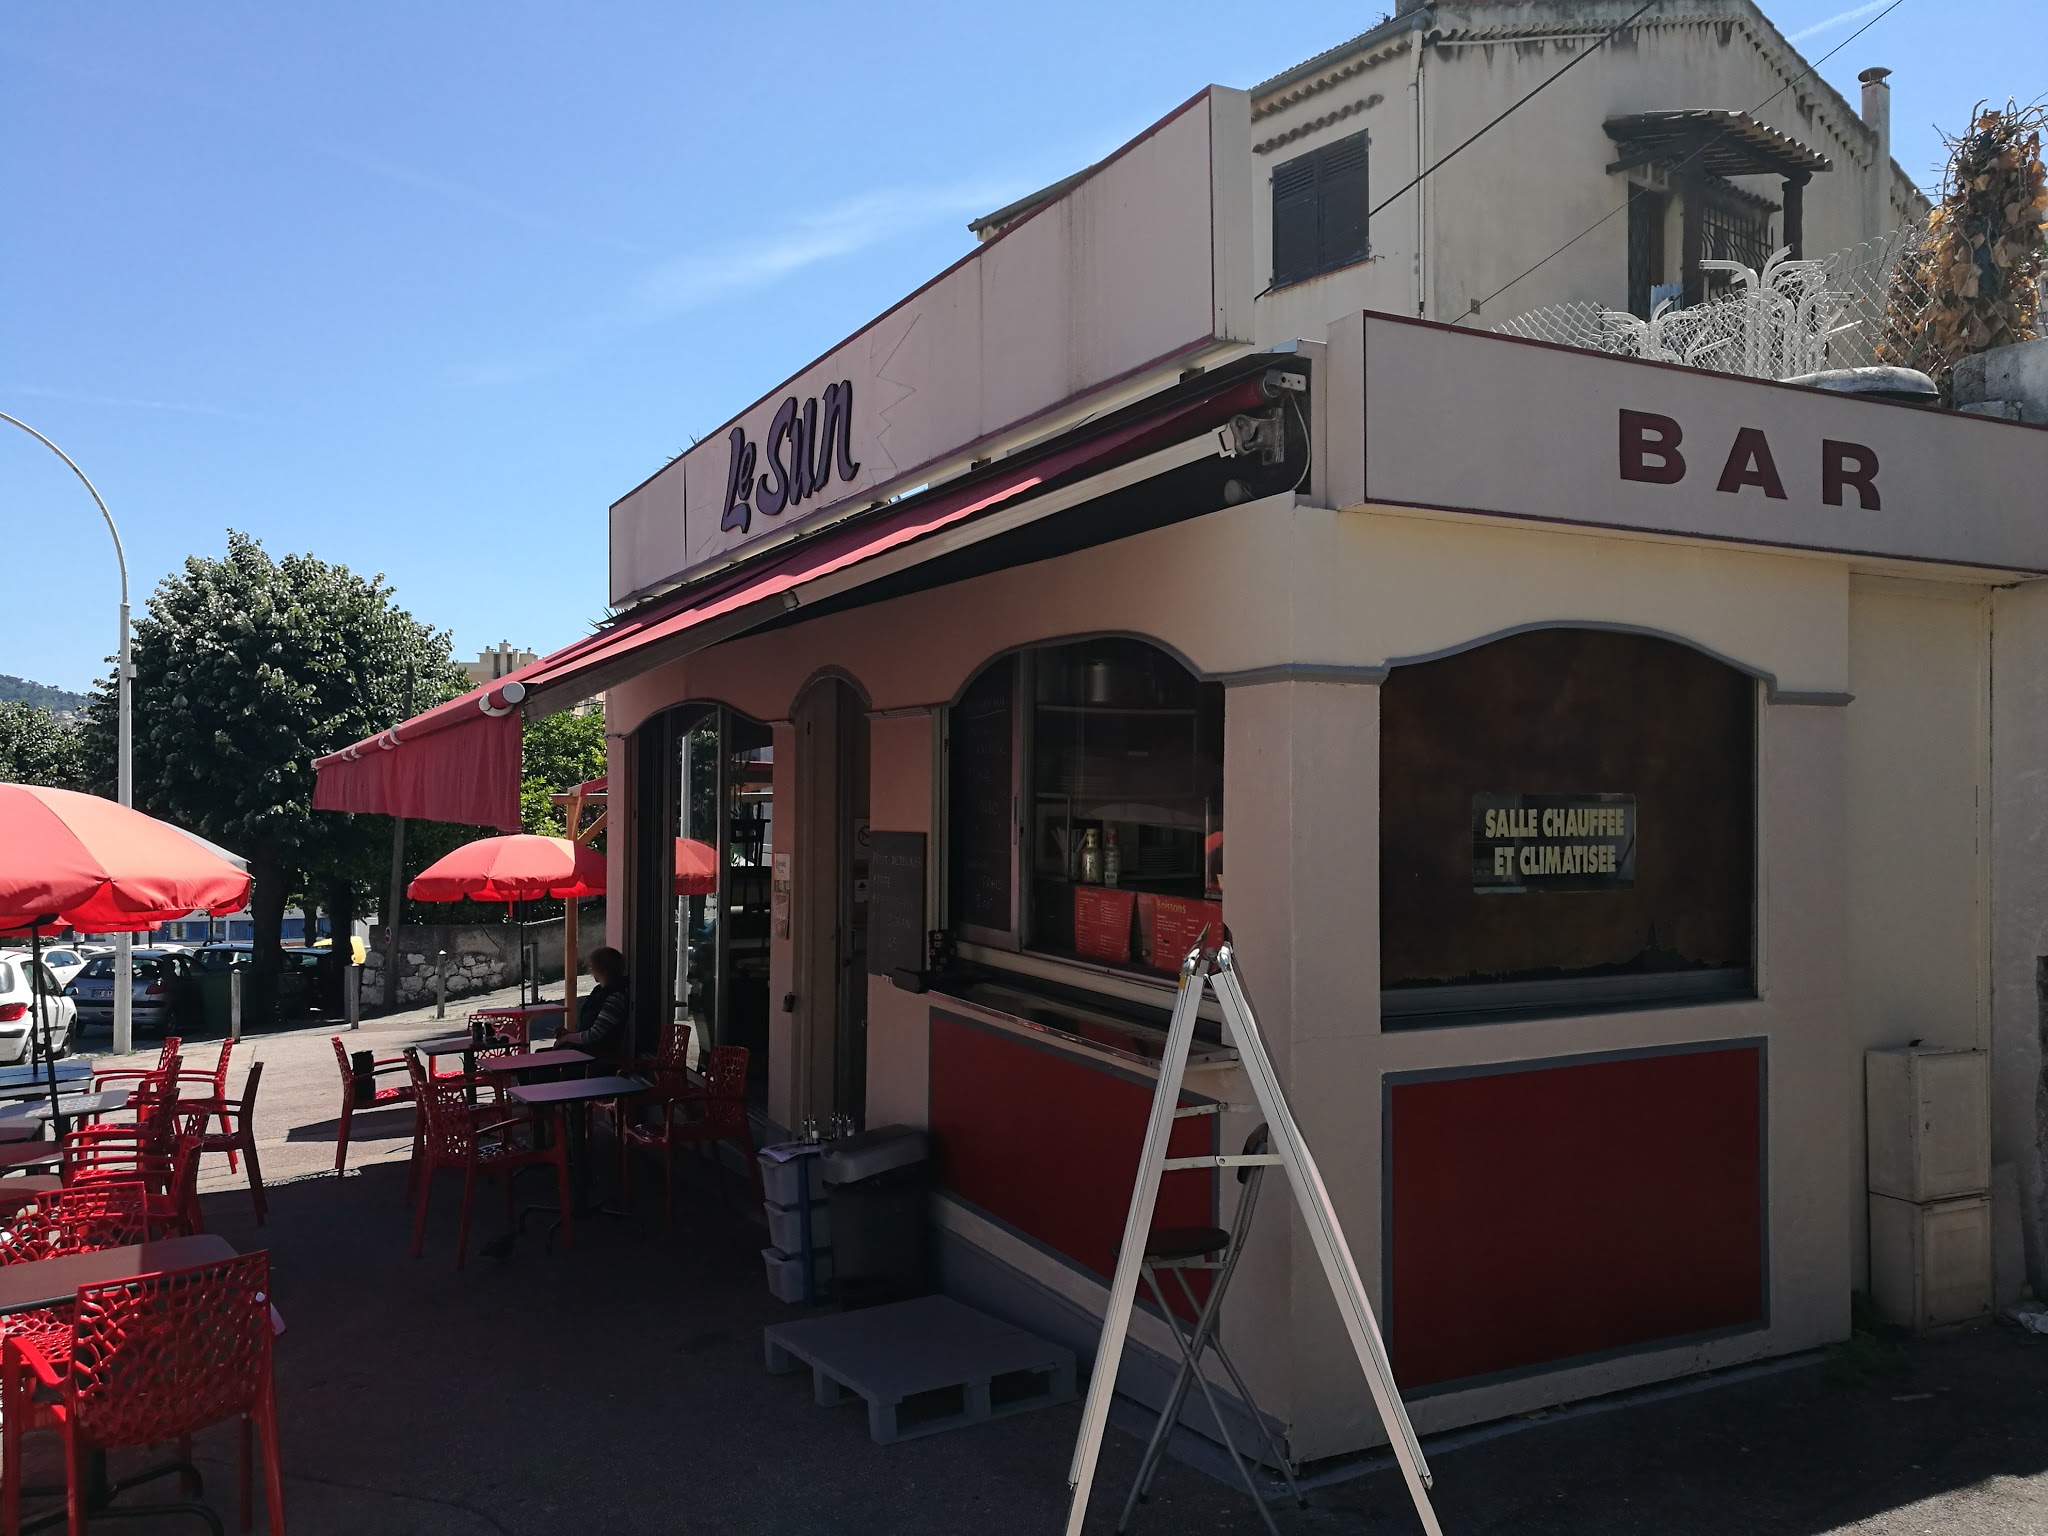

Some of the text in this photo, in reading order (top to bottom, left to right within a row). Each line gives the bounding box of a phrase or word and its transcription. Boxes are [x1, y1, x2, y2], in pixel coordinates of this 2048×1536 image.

[1619, 408, 1881, 511] BAR
[1485, 808, 1625, 838] SALLE CHAUFFEE
[1494, 845, 1617, 876] ET CLIMATISEE
